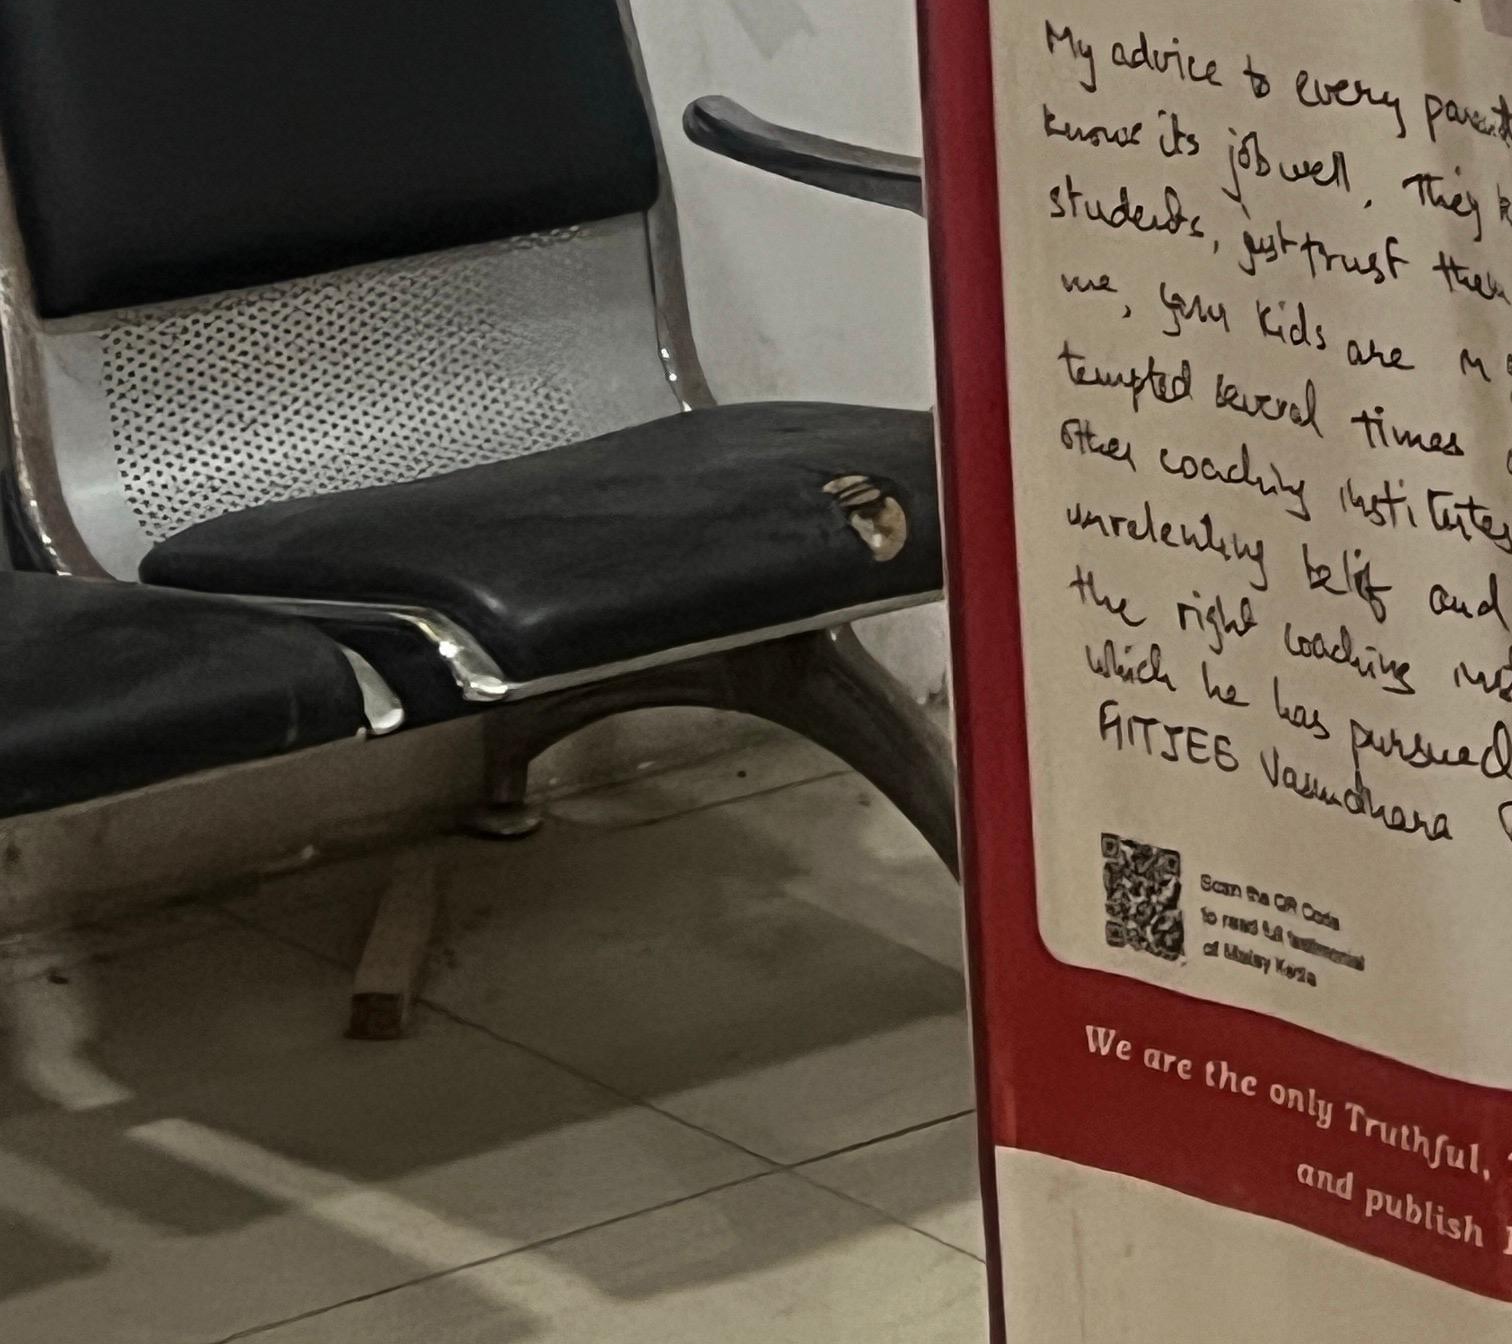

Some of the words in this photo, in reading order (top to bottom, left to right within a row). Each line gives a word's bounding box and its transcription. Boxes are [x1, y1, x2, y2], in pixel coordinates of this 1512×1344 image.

[1044, 19, 1097, 93] My
[1111, 32, 1223, 87] advice
[1243, 54, 1271, 98] to
[1296, 70, 1406, 138] every
[1258, 301, 1327, 350] kids
[1347, 340, 1415, 370] are
[1351, 406, 1465, 456] times
[1160, 443, 1311, 522] coaching
[1070, 564, 1147, 627] the
[1177, 589, 1258, 655] right
[1428, 572, 1510, 633] and
[1202, 661, 1250, 708] he
[1273, 676, 1330, 739] has
[1085, 1024, 1133, 1061] We
[1143, 1047, 1193, 1080] are
[1205, 1061, 1257, 1097] the
[1269, 1081, 1334, 1130] only
[1344, 1101, 1492, 1183] Truthful,
[1296, 1162, 1353, 1200] and
[1365, 1185, 1484, 1247] publish
